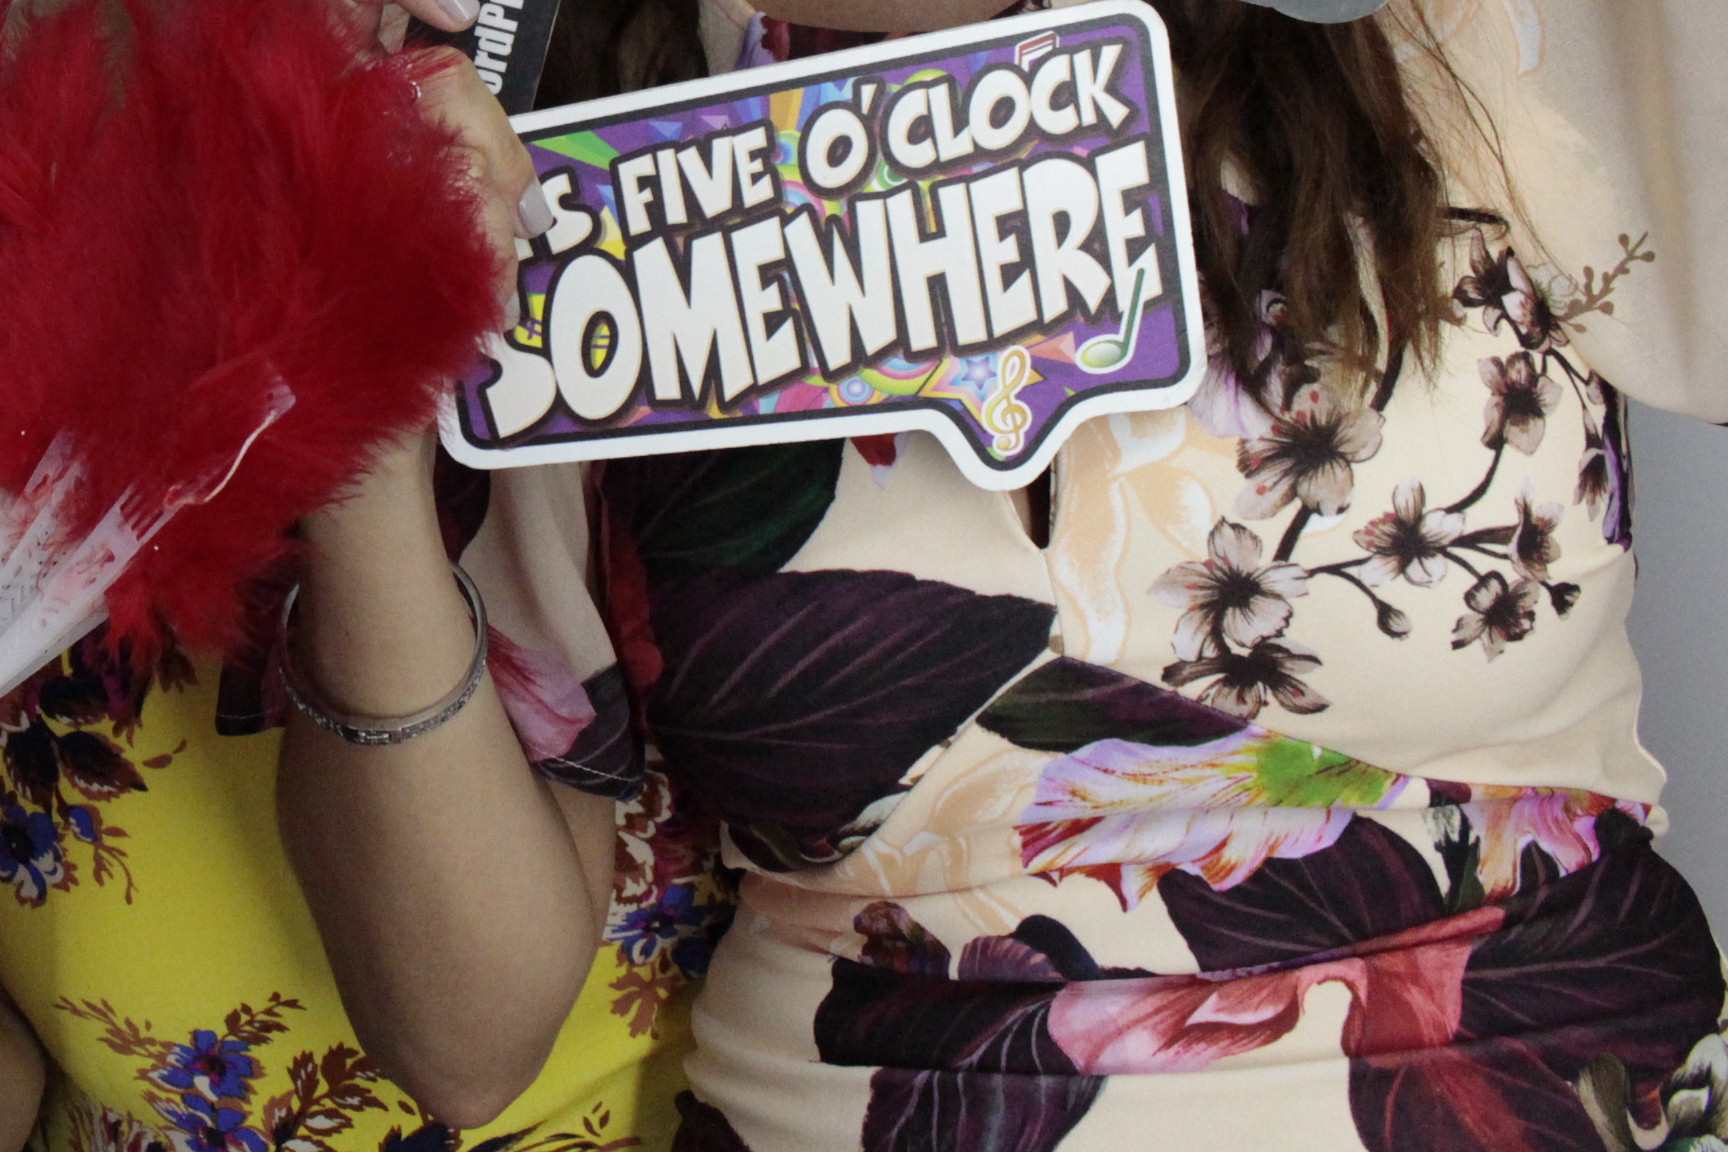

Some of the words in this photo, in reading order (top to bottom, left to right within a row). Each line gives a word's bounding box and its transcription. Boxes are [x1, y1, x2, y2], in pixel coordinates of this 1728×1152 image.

[617, 125, 775, 237] FIVE
[805, 43, 1131, 189] O'CLOCK
[480, 139, 1163, 439] SOMEWHERE
